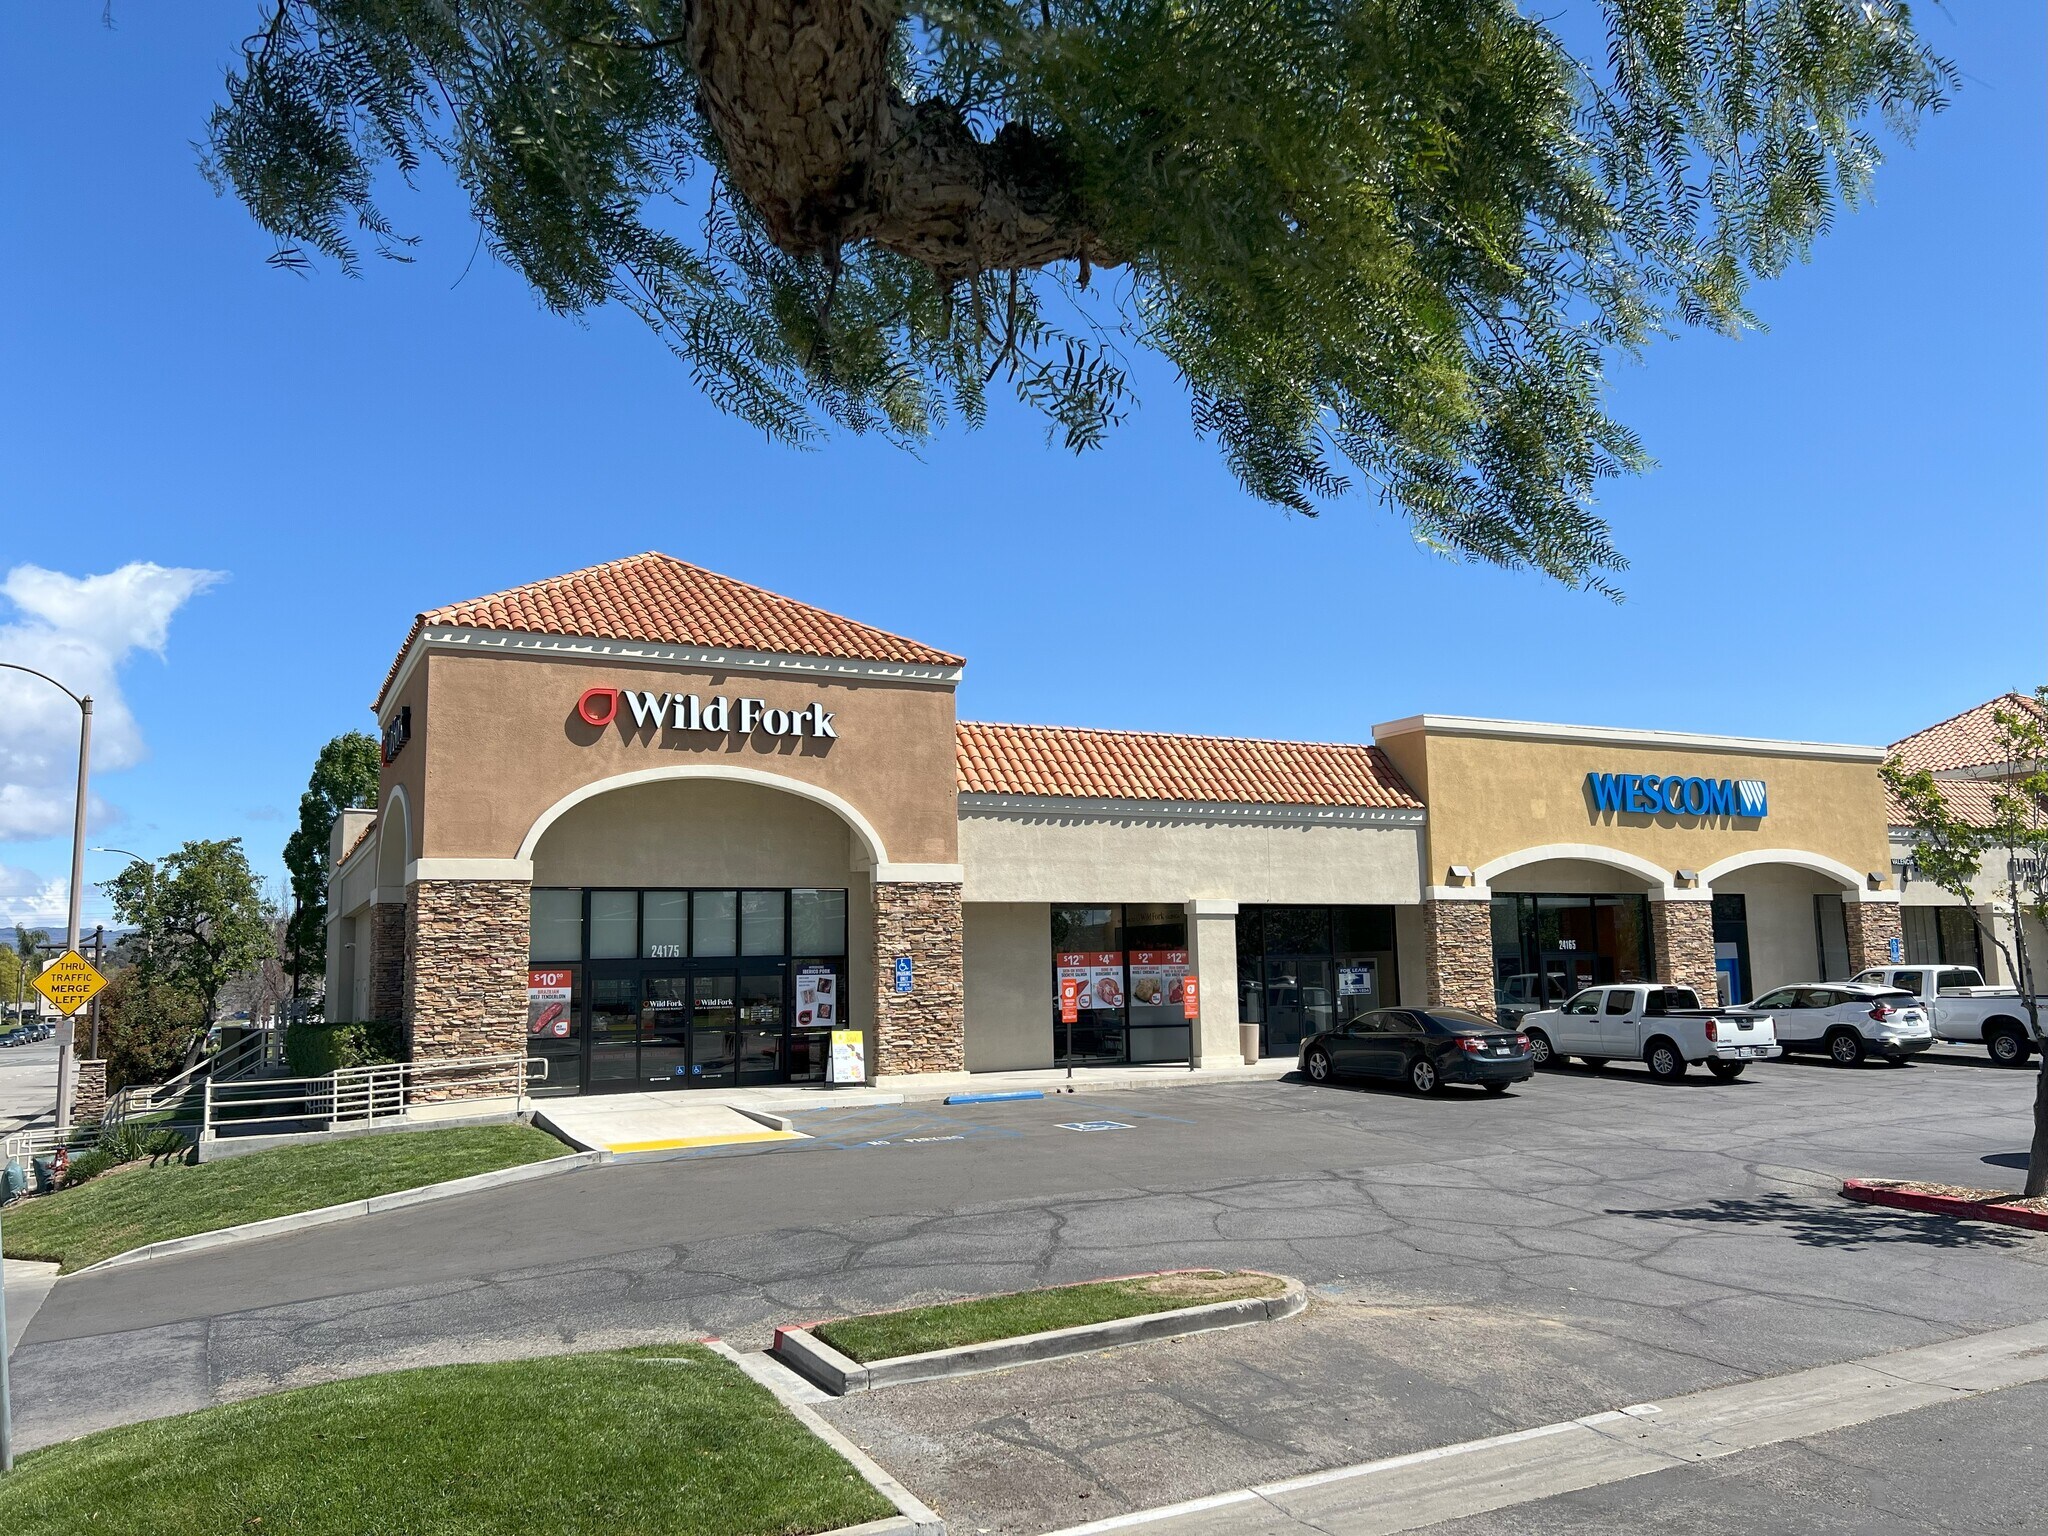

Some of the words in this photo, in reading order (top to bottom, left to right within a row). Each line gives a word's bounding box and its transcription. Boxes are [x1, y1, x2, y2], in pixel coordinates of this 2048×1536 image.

[623, 689, 730, 732] Wild
[738, 697, 839, 738] Fork
[1587, 772, 1735, 816] WESCOM
[1559, 939, 1577, 950] 24165
[651, 945, 680, 958] 24175
[51, 974, 92, 982] TRAFFIC
[55, 996, 85, 1004] LEFT
[717, 998, 733, 1006] Fork
